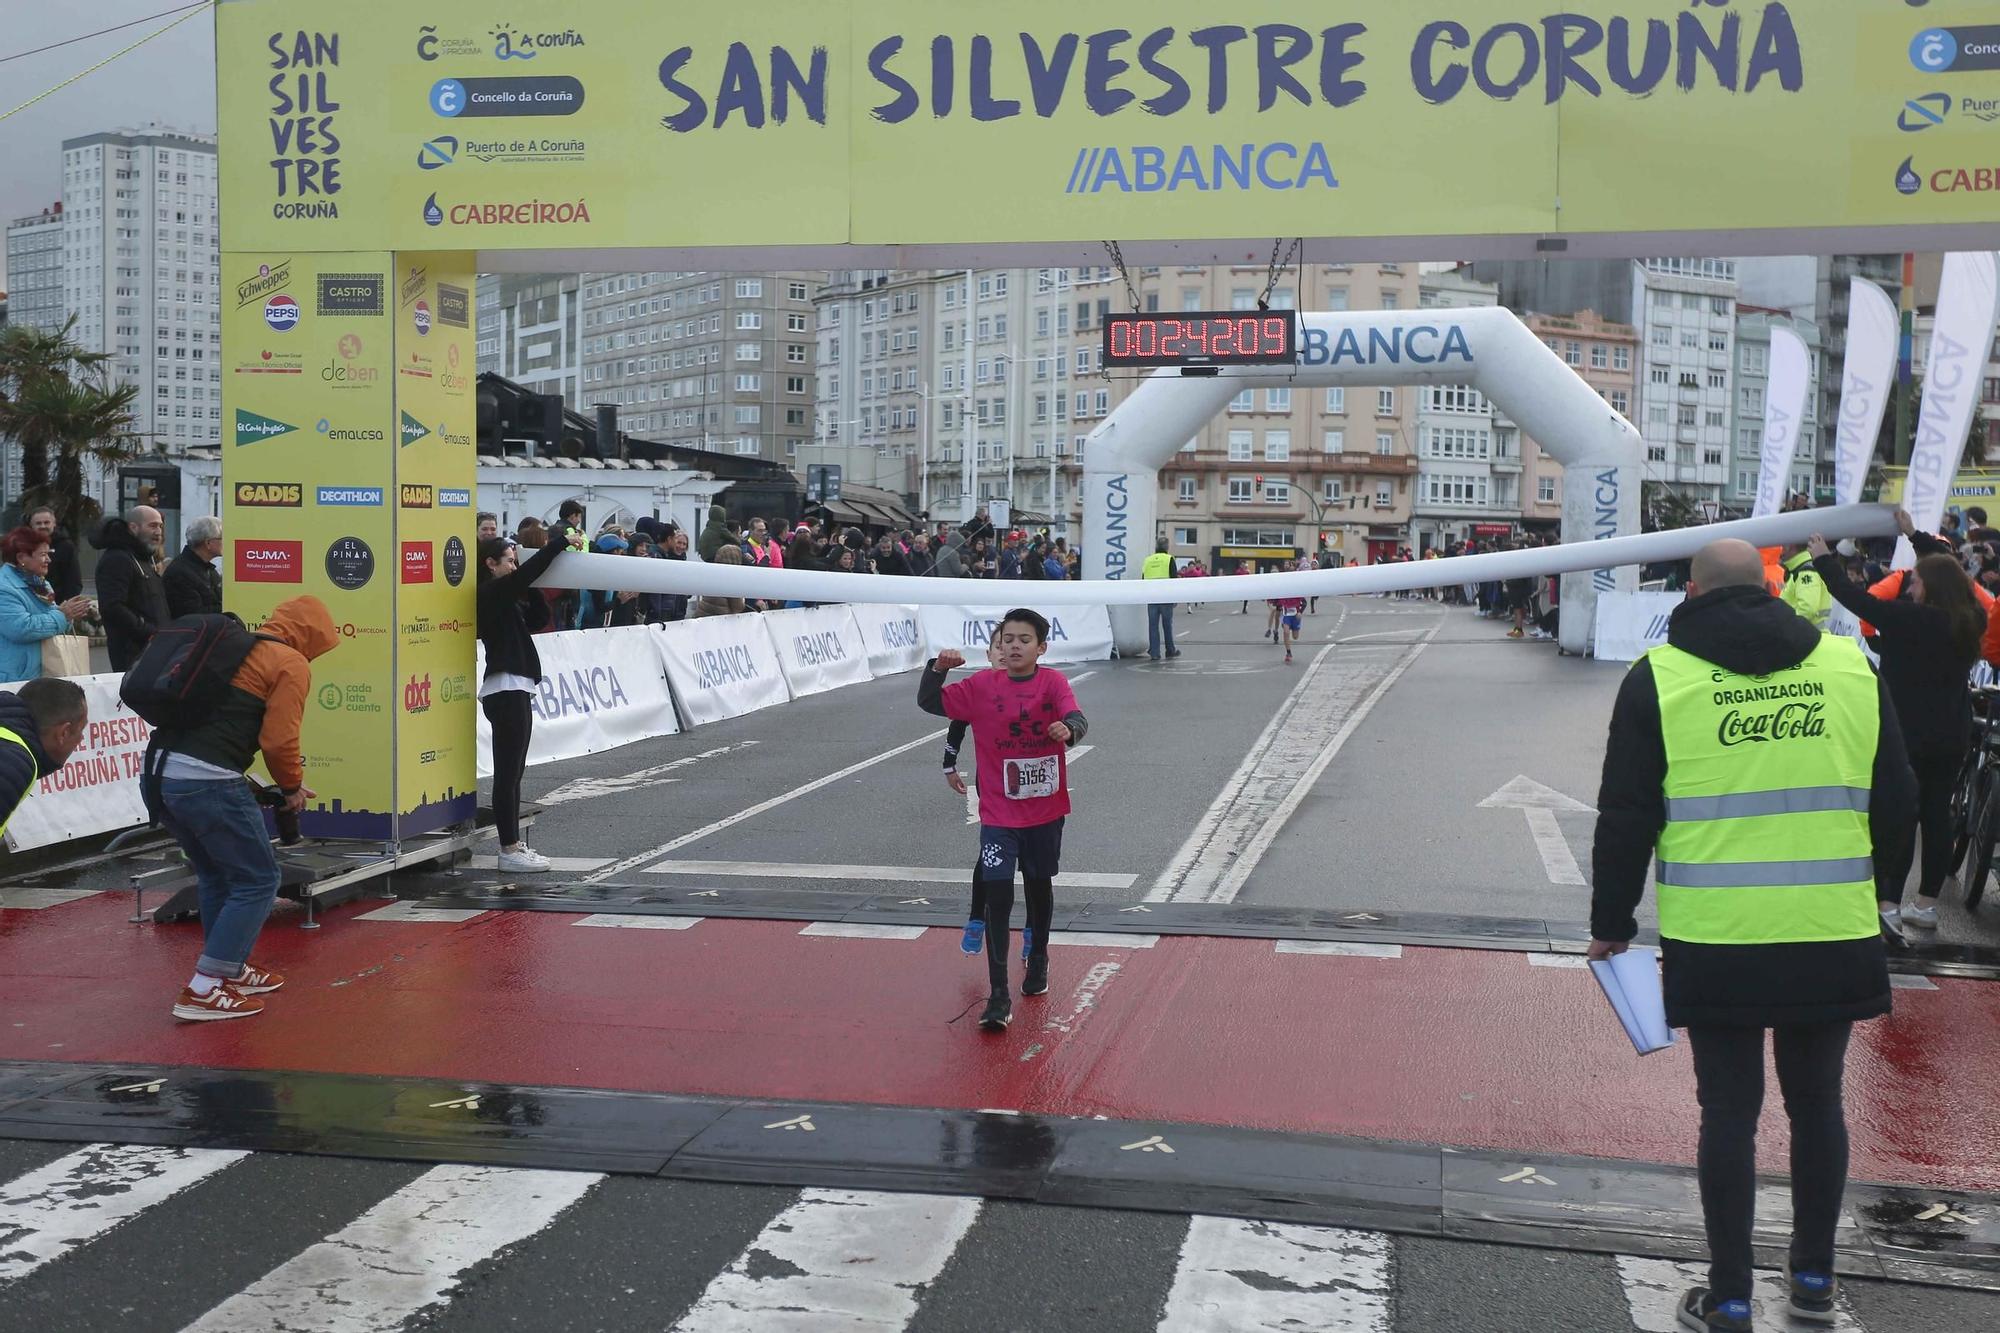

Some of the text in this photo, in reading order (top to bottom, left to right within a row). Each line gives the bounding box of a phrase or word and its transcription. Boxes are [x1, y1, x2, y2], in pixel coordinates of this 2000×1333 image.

[269, 30, 339, 69] SAN
[659, 0, 1803, 132] SAN SILVESTRE CORUÑA
[269, 71, 340, 115] SIL
[471, 91, 573, 103] Concello da Coruña
[269, 116, 341, 155] VES
[466, 139, 585, 153] Puerto de A Coruña
[270, 159, 341, 197] TRE
[273, 200, 338, 219] CORUÑA
[238, 265, 291, 306] Schweppes
[329, 287, 372, 298] CASTRO
[442, 296, 464, 311] CASTRO
[265, 308, 299, 318] PEPSI
[414, 311, 431, 324] PEPSI
[329, 429, 383, 441] emalcsa
[239, 484, 300, 503] GADIS
[319, 490, 380, 502] DECATHLON
[402, 486, 431, 504] GADIS
[440, 492, 469, 504] DECATHLON
[345, 541, 356, 549] EL
[451, 540, 458, 548] EL
[246, 550, 288, 560] CUMA
[333, 550, 368, 559] PINAR
[405, 551, 426, 562] CUMA
[446, 548, 463, 557] PINAR
[346, 683, 372, 694] cada
[1713, 679, 1825, 706] ORGANIZACIÓN
[346, 692, 366, 703] lata
[346, 702, 381, 713] cuenta
[1718, 701, 1827, 747] Coca-Cola
[89, 717, 149, 750] PRESTA
[53, 750, 121, 792] CORUÑA
